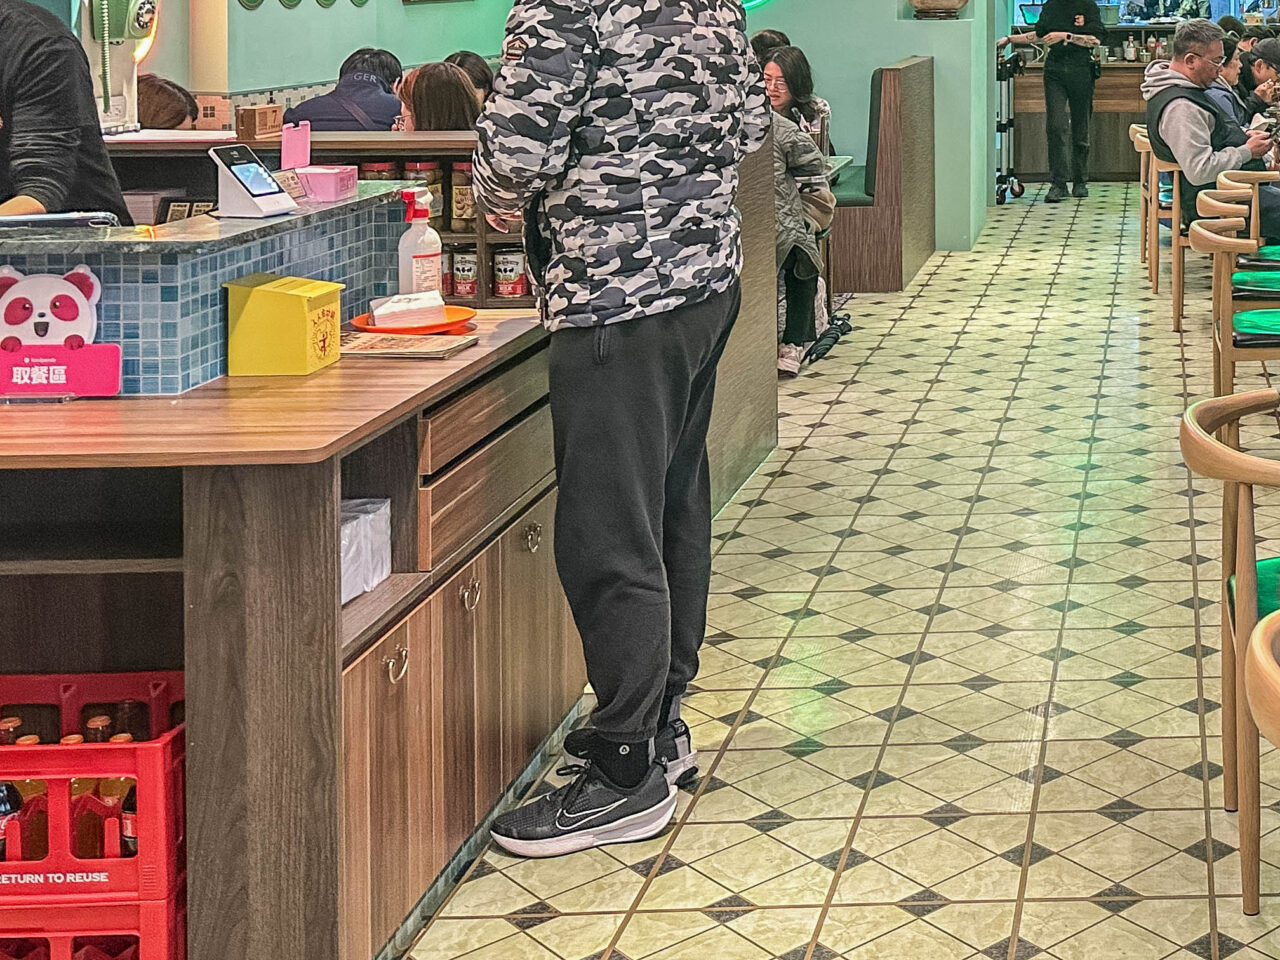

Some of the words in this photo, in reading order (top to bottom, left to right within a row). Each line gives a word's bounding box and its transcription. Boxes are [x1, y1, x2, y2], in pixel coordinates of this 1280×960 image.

[272, 110, 278, 124] 7
[12, 366, 67, 384] 取餐區
[0, 873, 44, 884] ETURN
[47, 873, 64, 883] TO
[66, 872, 109, 883] REUSE
